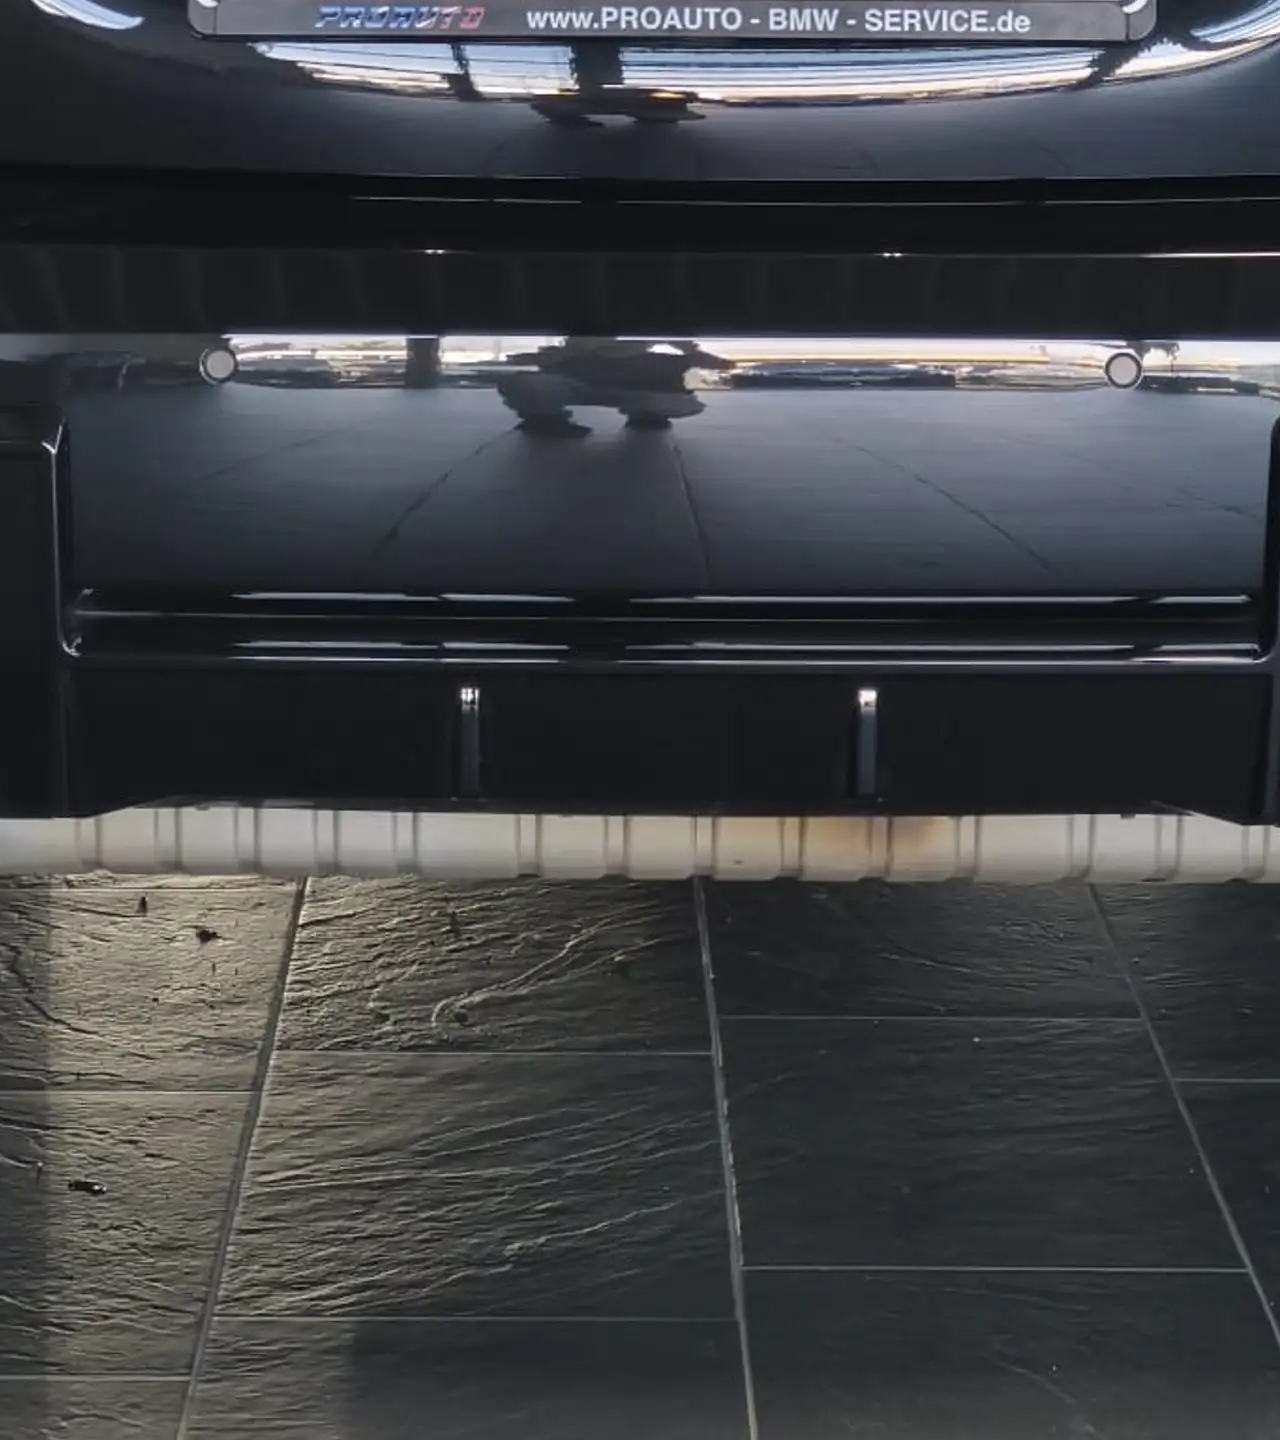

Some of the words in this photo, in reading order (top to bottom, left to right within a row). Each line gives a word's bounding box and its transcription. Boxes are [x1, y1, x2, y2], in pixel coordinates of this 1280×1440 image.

[314, 5, 486, 30] PROAUTO
[526, 6, 743, 31] www.PROAUTO
[768, 9, 840, 32] BMW
[864, 10, 1032, 34] SERVICE.de
